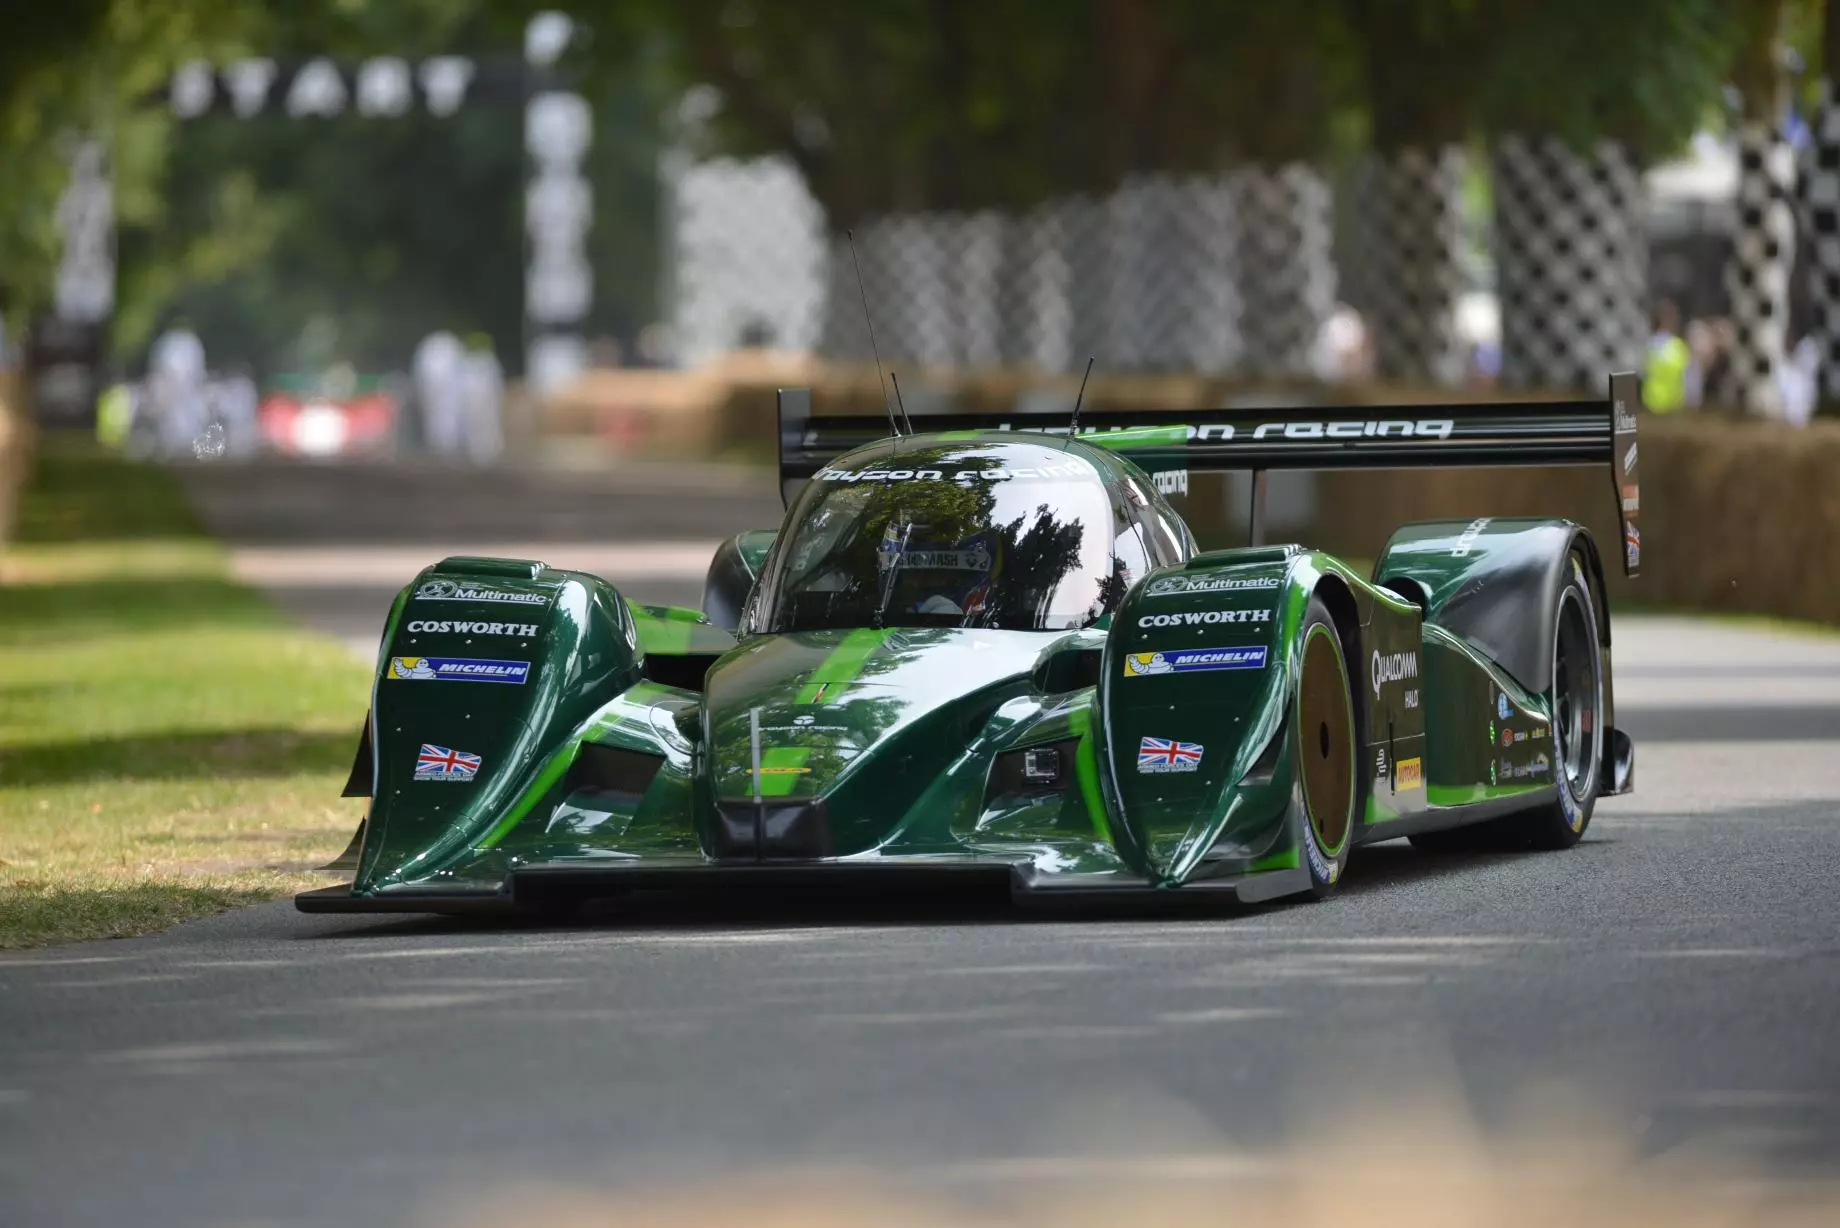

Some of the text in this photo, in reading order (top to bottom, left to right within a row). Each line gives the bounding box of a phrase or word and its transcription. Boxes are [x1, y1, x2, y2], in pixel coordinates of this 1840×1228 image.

[1253, 420, 1454, 440] racing
[1185, 577, 1280, 591] Multimatic
[454, 589, 547, 603] Multimatic
[1138, 609, 1272, 628] COSWORTH
[407, 620, 539, 637] COSWORTH
[1175, 651, 1264, 664] MICHELIN
[438, 663, 527, 675] MICHELIN
[1371, 649, 1418, 702] QUALCOMM
